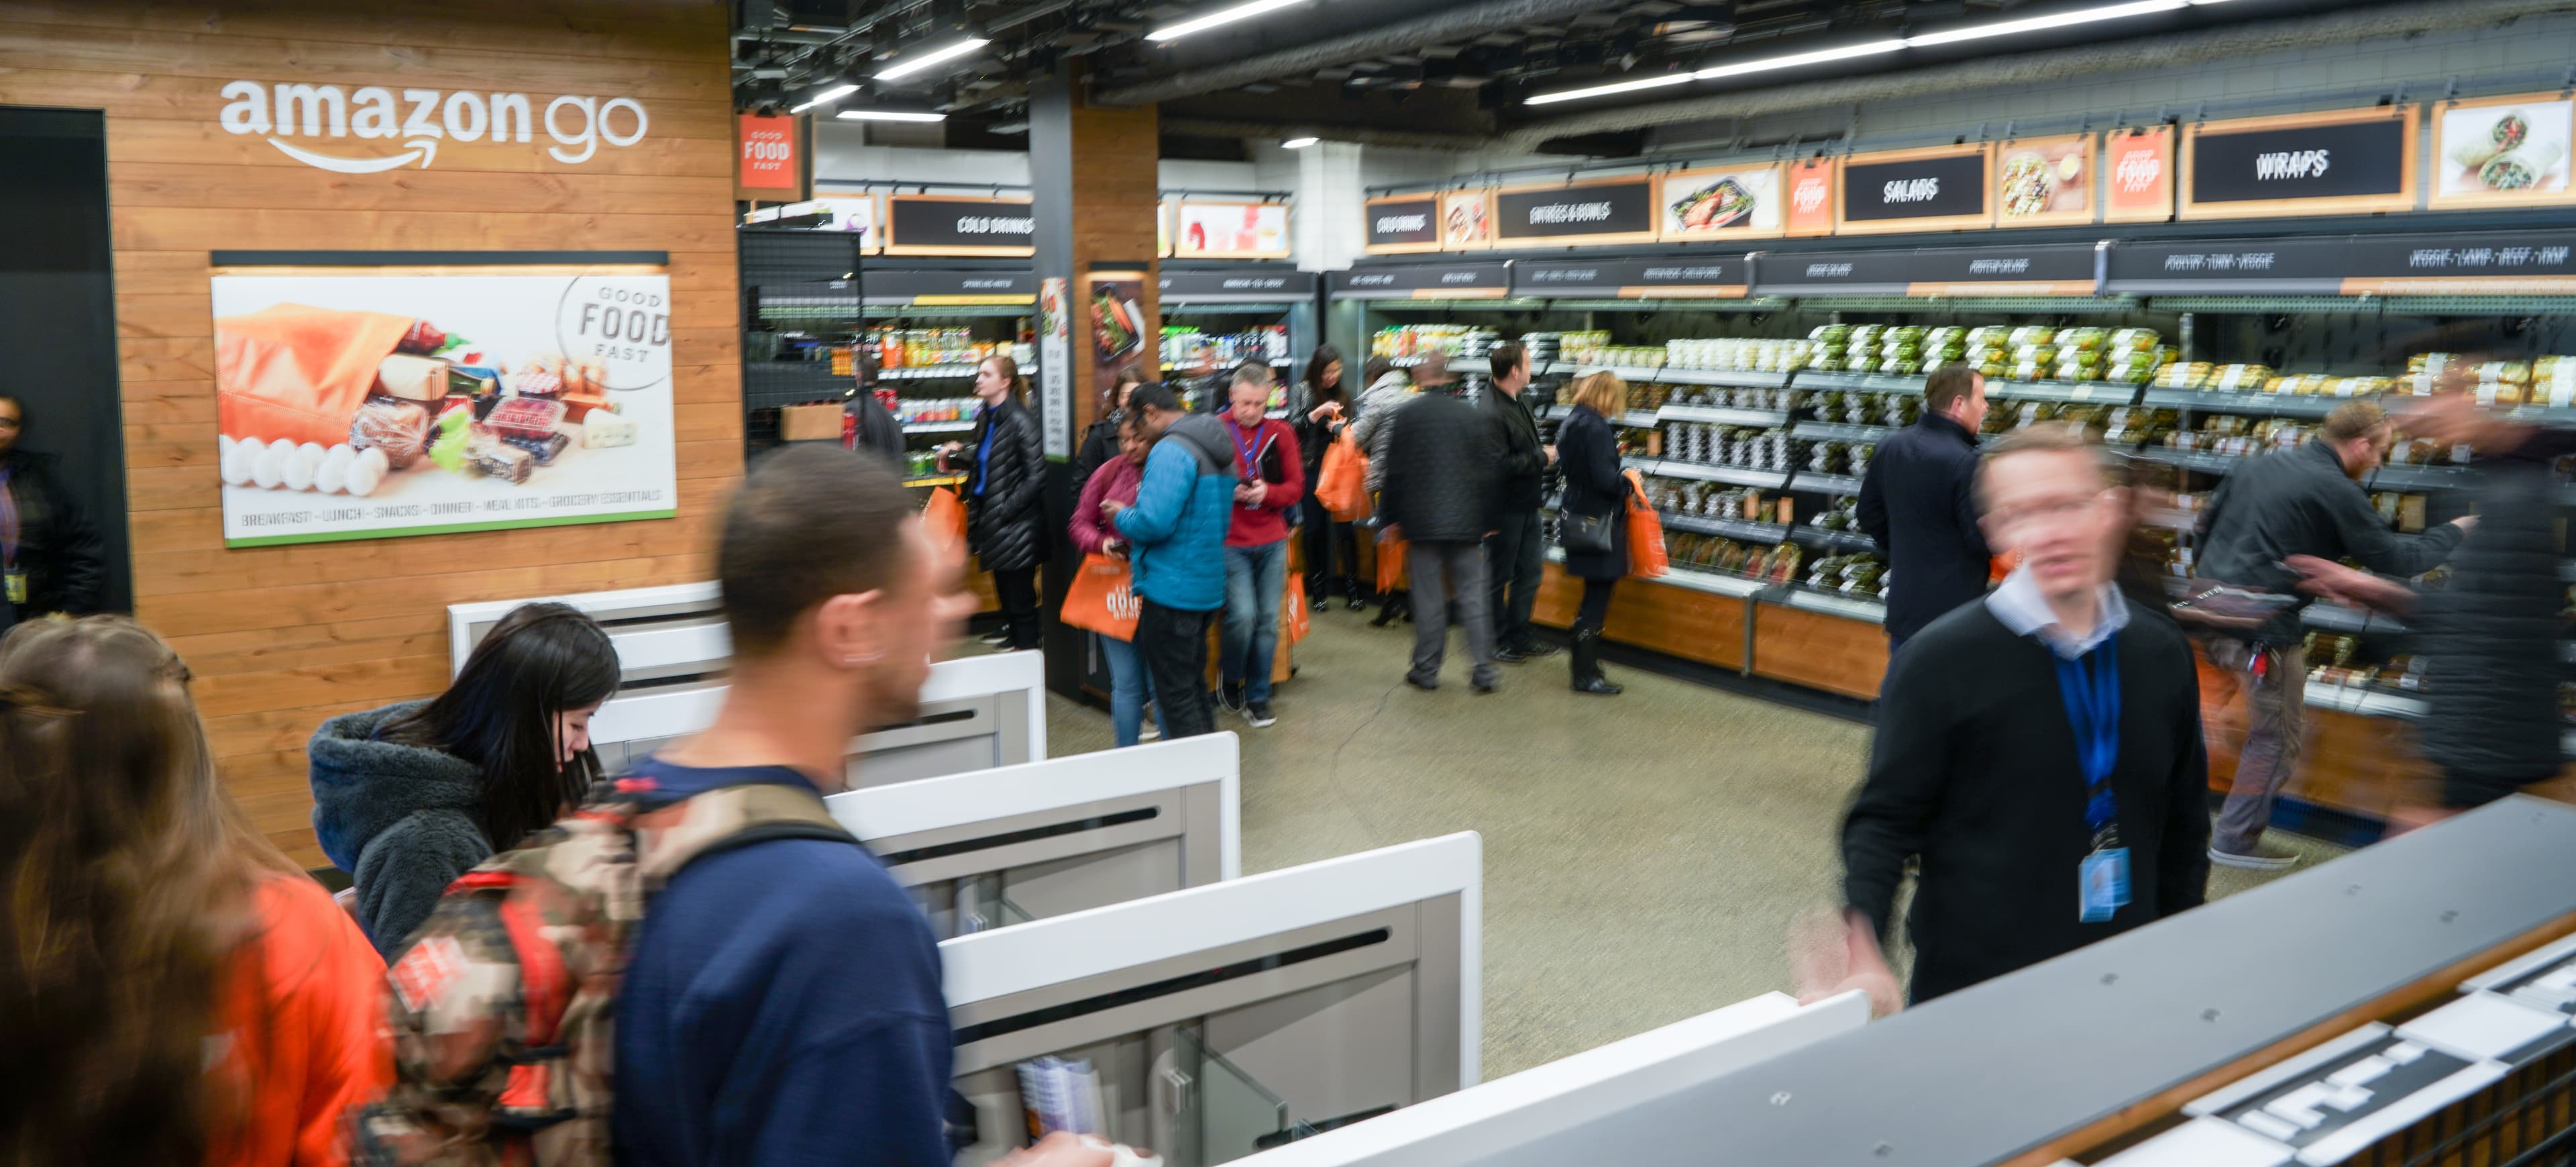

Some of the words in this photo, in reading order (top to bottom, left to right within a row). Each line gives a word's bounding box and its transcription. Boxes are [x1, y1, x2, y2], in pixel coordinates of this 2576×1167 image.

[219, 80, 532, 144] amazon
[544, 95, 649, 165] go
[744, 141, 790, 160] FOOD
[753, 161, 782, 170] FAST
[2256, 148, 2330, 181] WRAPS
[1883, 177, 1939, 204] SALADS
[957, 216, 991, 234] COLD
[990, 217, 1036, 235] DRINKS
[2164, 254, 2205, 271] POULTRY
[2207, 254, 2234, 270] TUNA
[2239, 252, 2275, 270] VEGGIE
[2410, 249, 2453, 268] VEGGIE
[2457, 248, 2492, 267] LAMB
[2498, 247, 2532, 266] BEEF
[2538, 246, 2570, 265] HAM
[598, 287, 661, 307] GOOD
[578, 302, 670, 348] FOOD
[594, 343, 649, 363] FAST
[241, 510, 311, 527] BREAKFAST
[322, 508, 364, 522] LUNCH
[374, 503, 421, 520] SNACKS
[430, 501, 474, 515] DINNER
